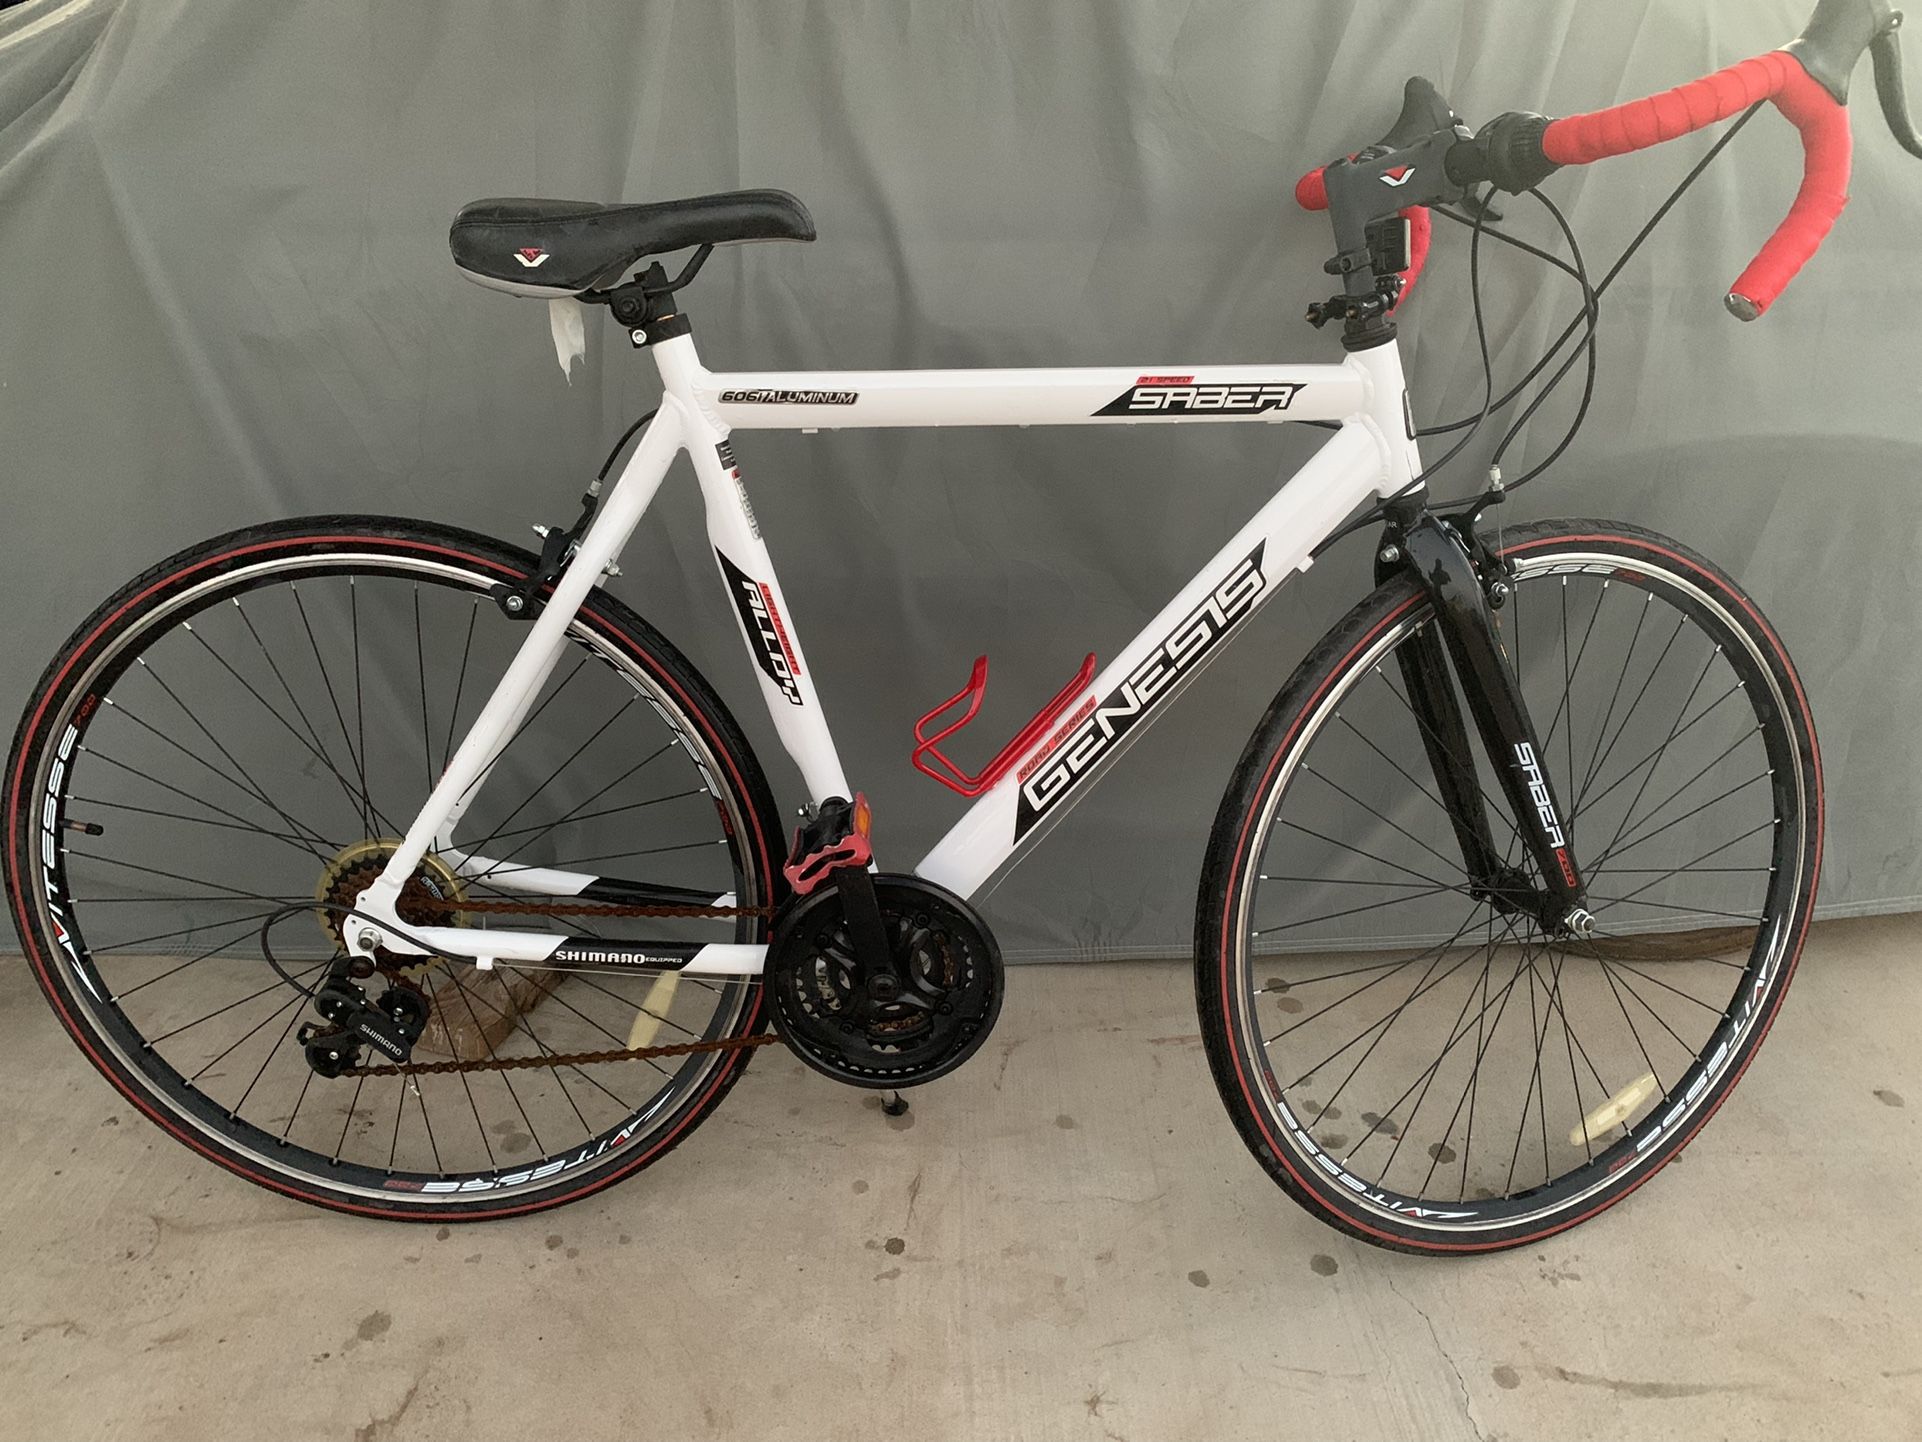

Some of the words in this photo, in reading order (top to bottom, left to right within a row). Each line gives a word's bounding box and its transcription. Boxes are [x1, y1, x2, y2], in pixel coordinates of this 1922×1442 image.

[1157, 375, 1191, 385] SPEED
[721, 390, 763, 401] 6061
[765, 391, 856, 405] ALUMINUM
[1128, 386, 1293, 410] SABER
[741, 580, 801, 704] ALLOY
[1023, 558, 1265, 812] GENESIS
[1018, 742, 1051, 781] ROAD
[1053, 700, 1095, 745] SERIES
[1513, 742, 1566, 849] SABER
[1556, 848, 1576, 886] 700
[555, 950, 646, 964] SHIMANO
[360, 1023, 403, 1056] SHIMANO
